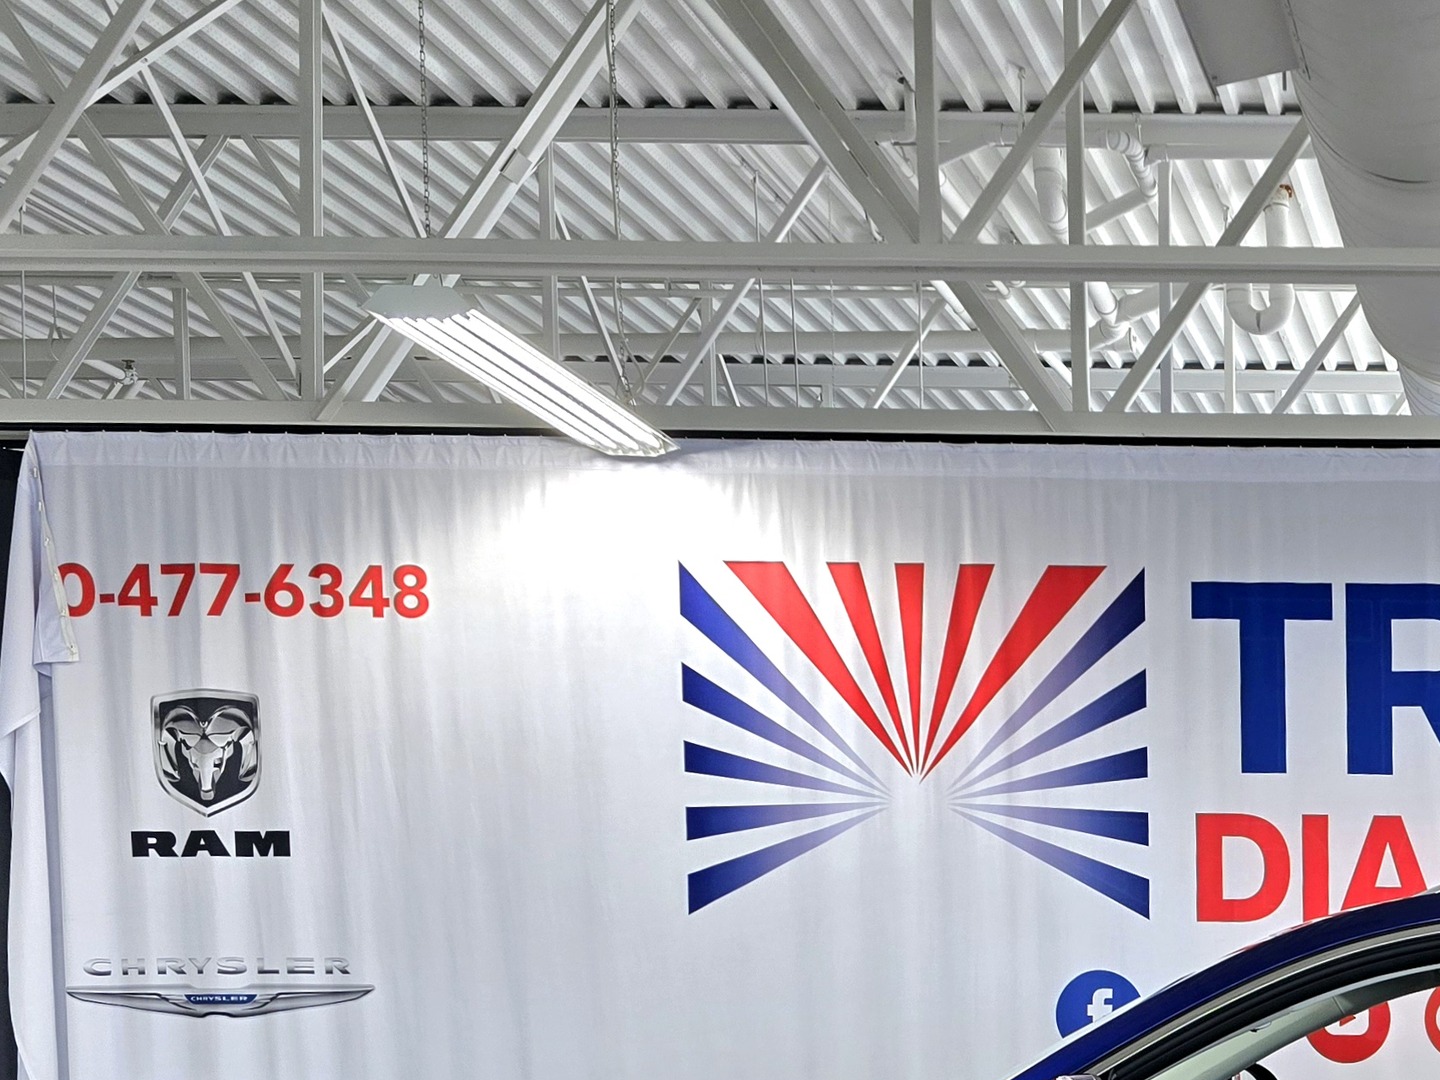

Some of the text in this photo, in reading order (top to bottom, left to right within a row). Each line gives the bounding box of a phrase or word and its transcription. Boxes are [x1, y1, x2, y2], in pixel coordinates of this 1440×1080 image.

[57, 561, 430, 619] 0-477-6348
[130, 830, 292, 858] RAM
[82, 956, 351, 976] CHRYSLER
